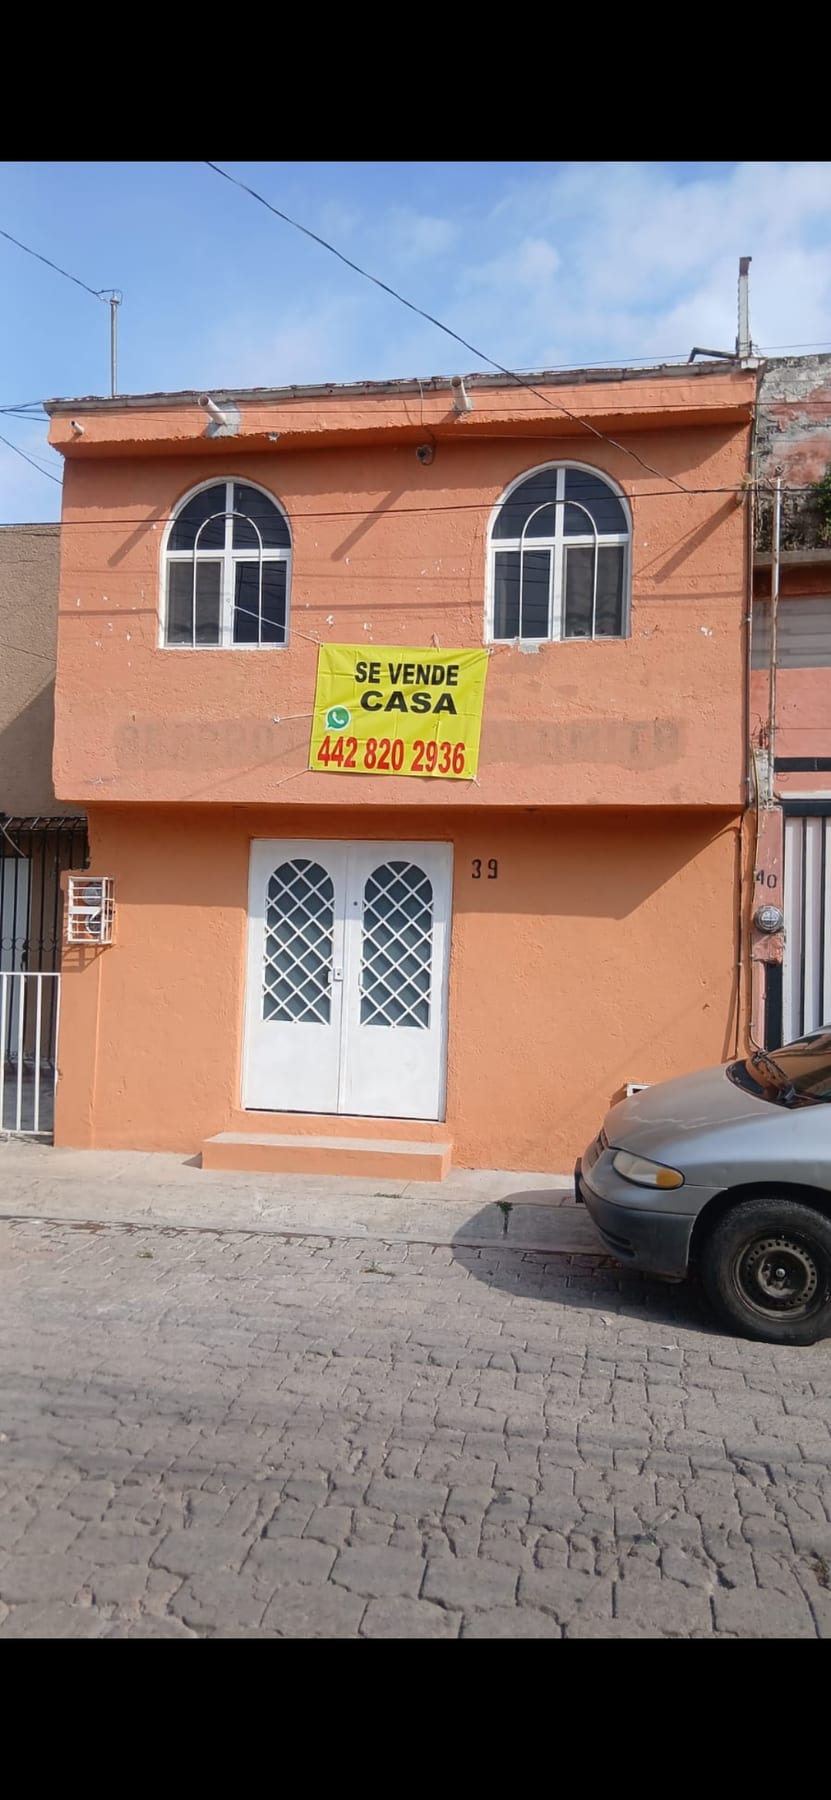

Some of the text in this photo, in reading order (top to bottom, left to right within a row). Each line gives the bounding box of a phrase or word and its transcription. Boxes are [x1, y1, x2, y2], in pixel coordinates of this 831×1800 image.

[354, 661, 460, 686] SE VENDE
[360, 690, 457, 715] CASA
[317, 735, 358, 768] 442
[363, 737, 405, 771] 820
[410, 740, 466, 774] 2936
[471, 858, 498, 879] 39
[755, 869, 778, 889] 40
